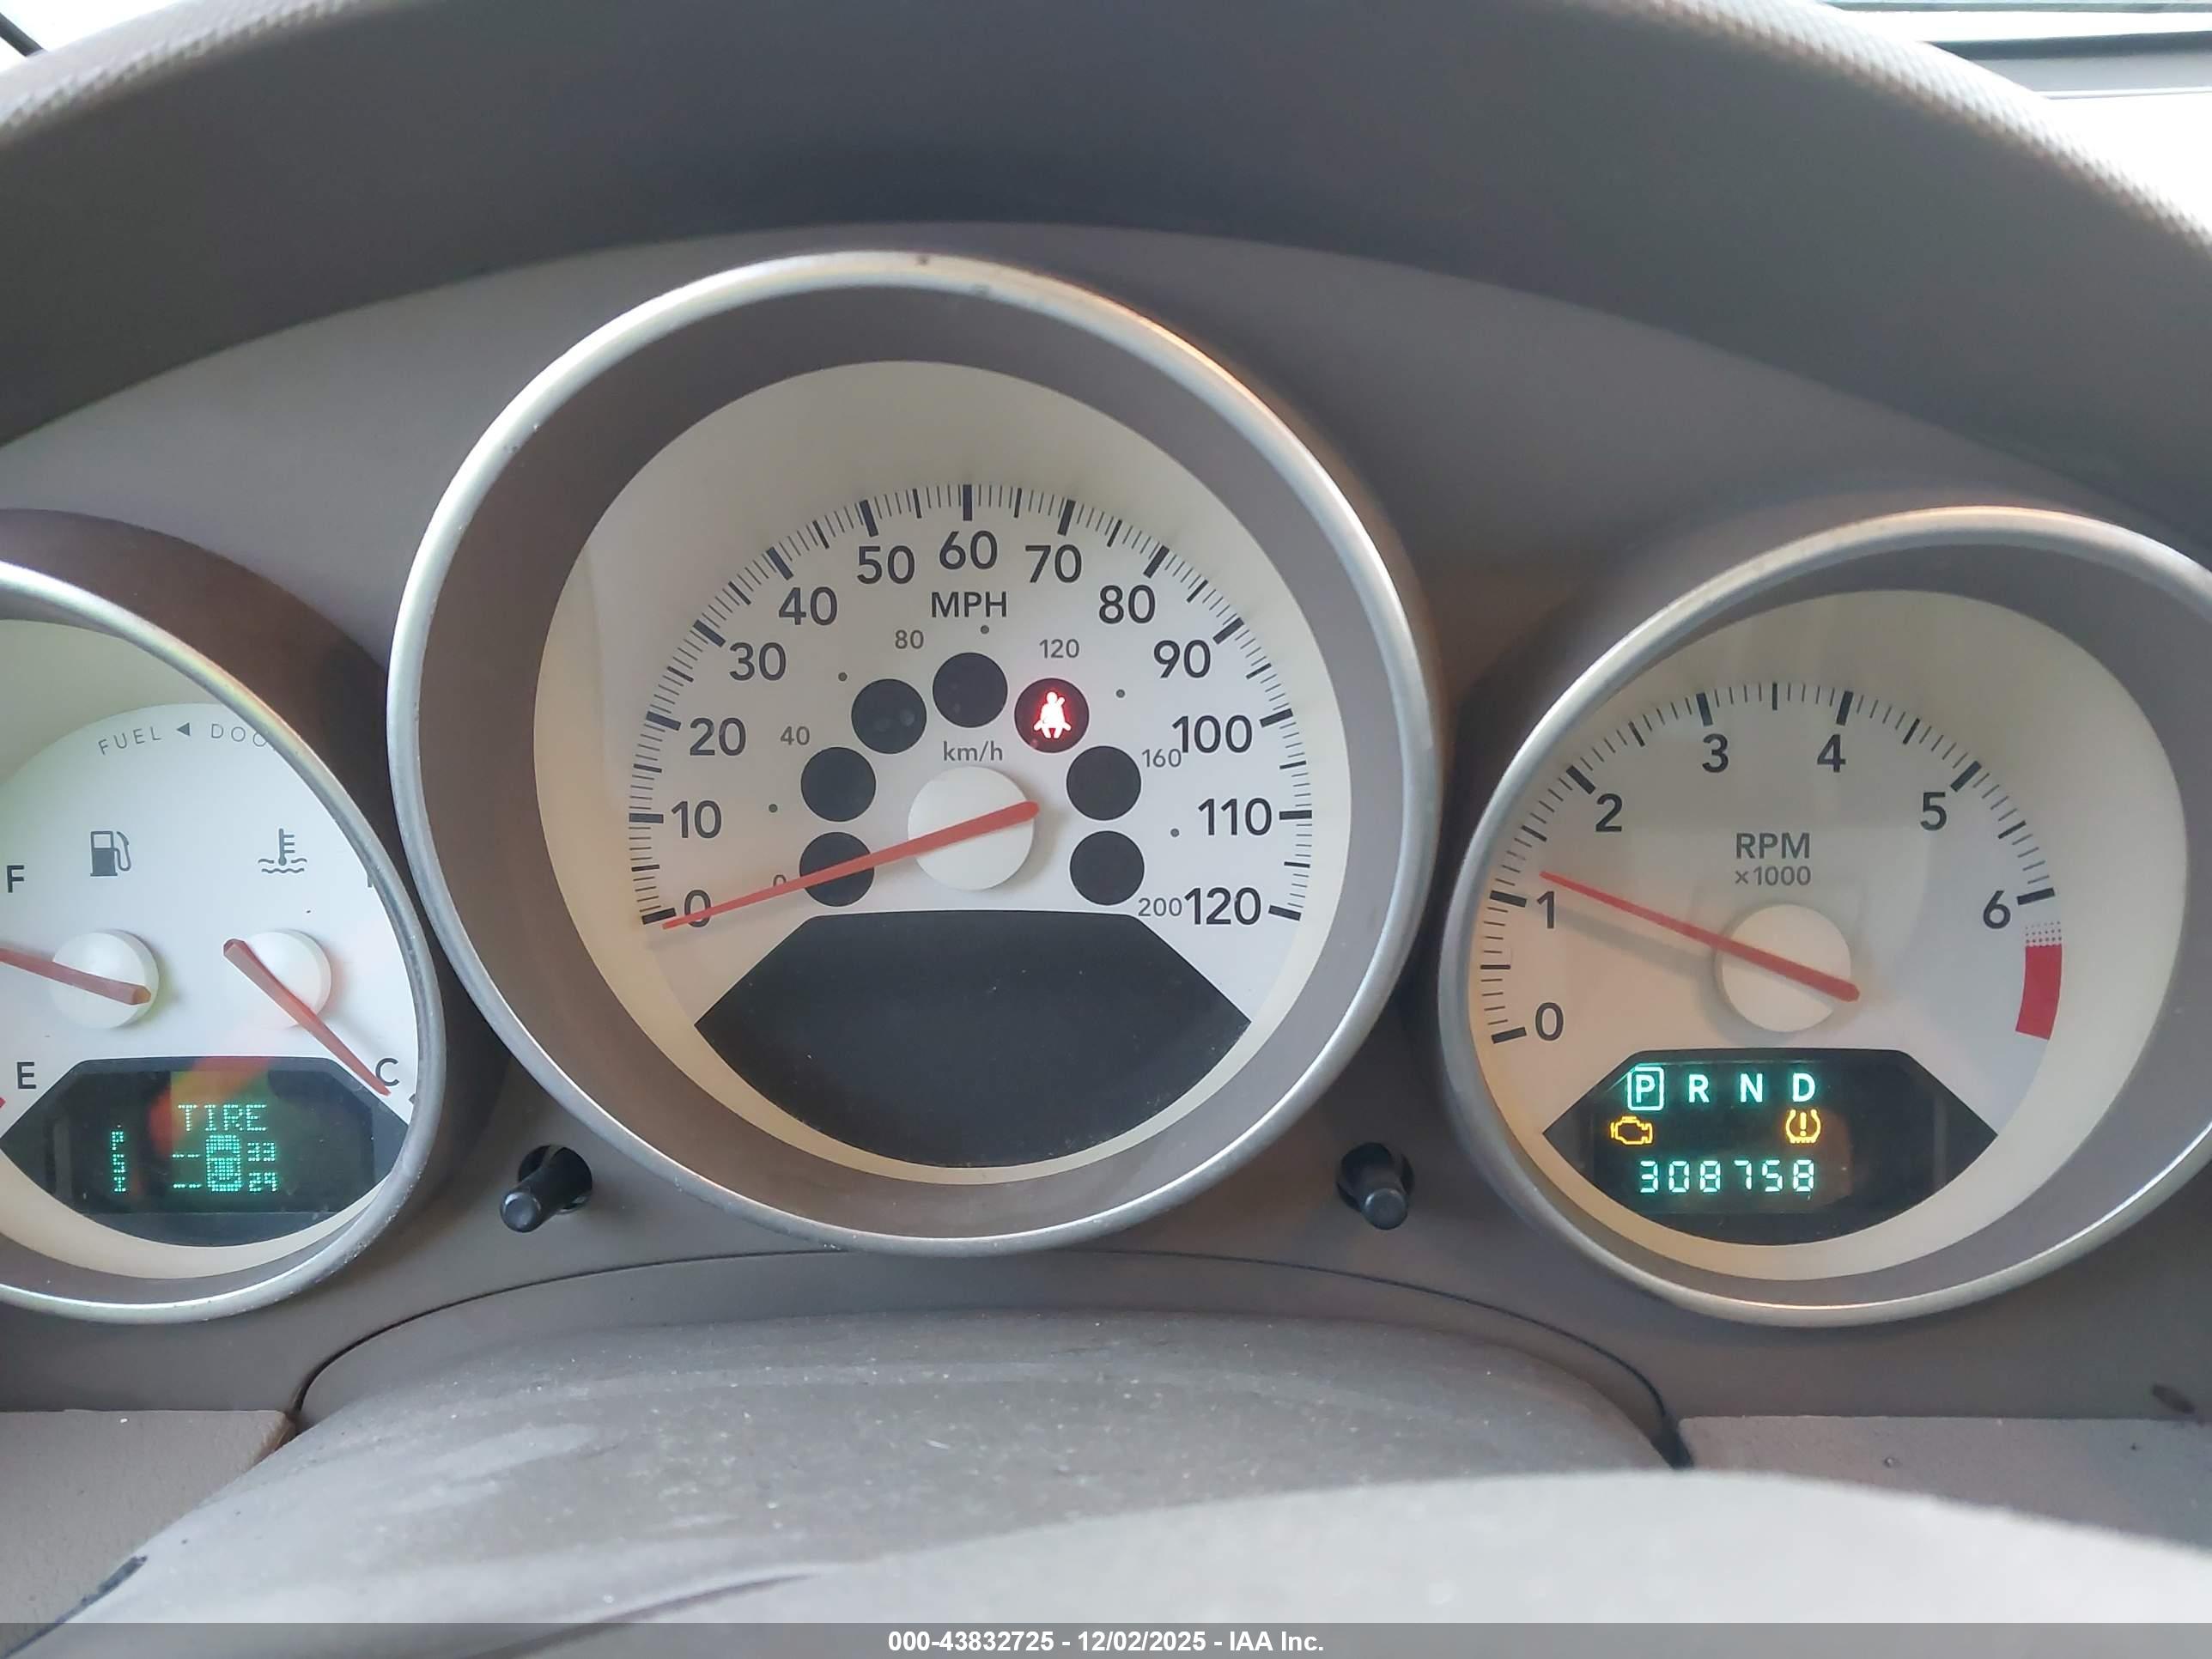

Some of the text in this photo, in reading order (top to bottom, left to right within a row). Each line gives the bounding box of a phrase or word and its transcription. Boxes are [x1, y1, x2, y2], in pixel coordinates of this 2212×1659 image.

[856, 545, 915, 585] 50
[939, 530, 998, 570] 60
[1024, 544, 1082, 584] 70
[778, 586, 838, 626] 40
[931, 591, 1007, 618] MPH
[1098, 585, 1156, 624] 80
[894, 629, 924, 650] 80
[1039, 638, 1080, 659] 120
[1153, 639, 1212, 678] 90
[728, 641, 787, 681] 30
[97, 723, 268, 756] FUEL DOO
[689, 717, 746, 757] 20
[780, 726, 811, 746] 40
[943, 739, 1003, 763] km/h
[1171, 715, 1253, 755] 100
[1702, 733, 1729, 772] 3
[1816, 733, 1846, 773] 4
[1141, 748, 1182, 769] 160
[671, 799, 722, 840] 10
[1198, 797, 1273, 836] 110
[1595, 793, 1623, 832] 2
[1920, 791, 1948, 831] 5
[1735, 832, 1810, 860] RPM
[6, 865, 25, 894] F
[684, 889, 712, 927] 0
[1138, 897, 1182, 917] 200
[1184, 887, 1261, 927] 120
[1537, 891, 1556, 929] 1
[1983, 890, 2011, 929] 6
[1534, 1001, 1565, 1042] 0
[15, 1061, 37, 1090] E
[375, 1057, 399, 1086] C
[1635, 1073, 1815, 1103] P R N D
[178, 1103, 267, 1132] TIRE
[247, 1142, 275, 1162] 33
[248, 1171, 277, 1192] 29
[1639, 1160, 1814, 1193] 308758
